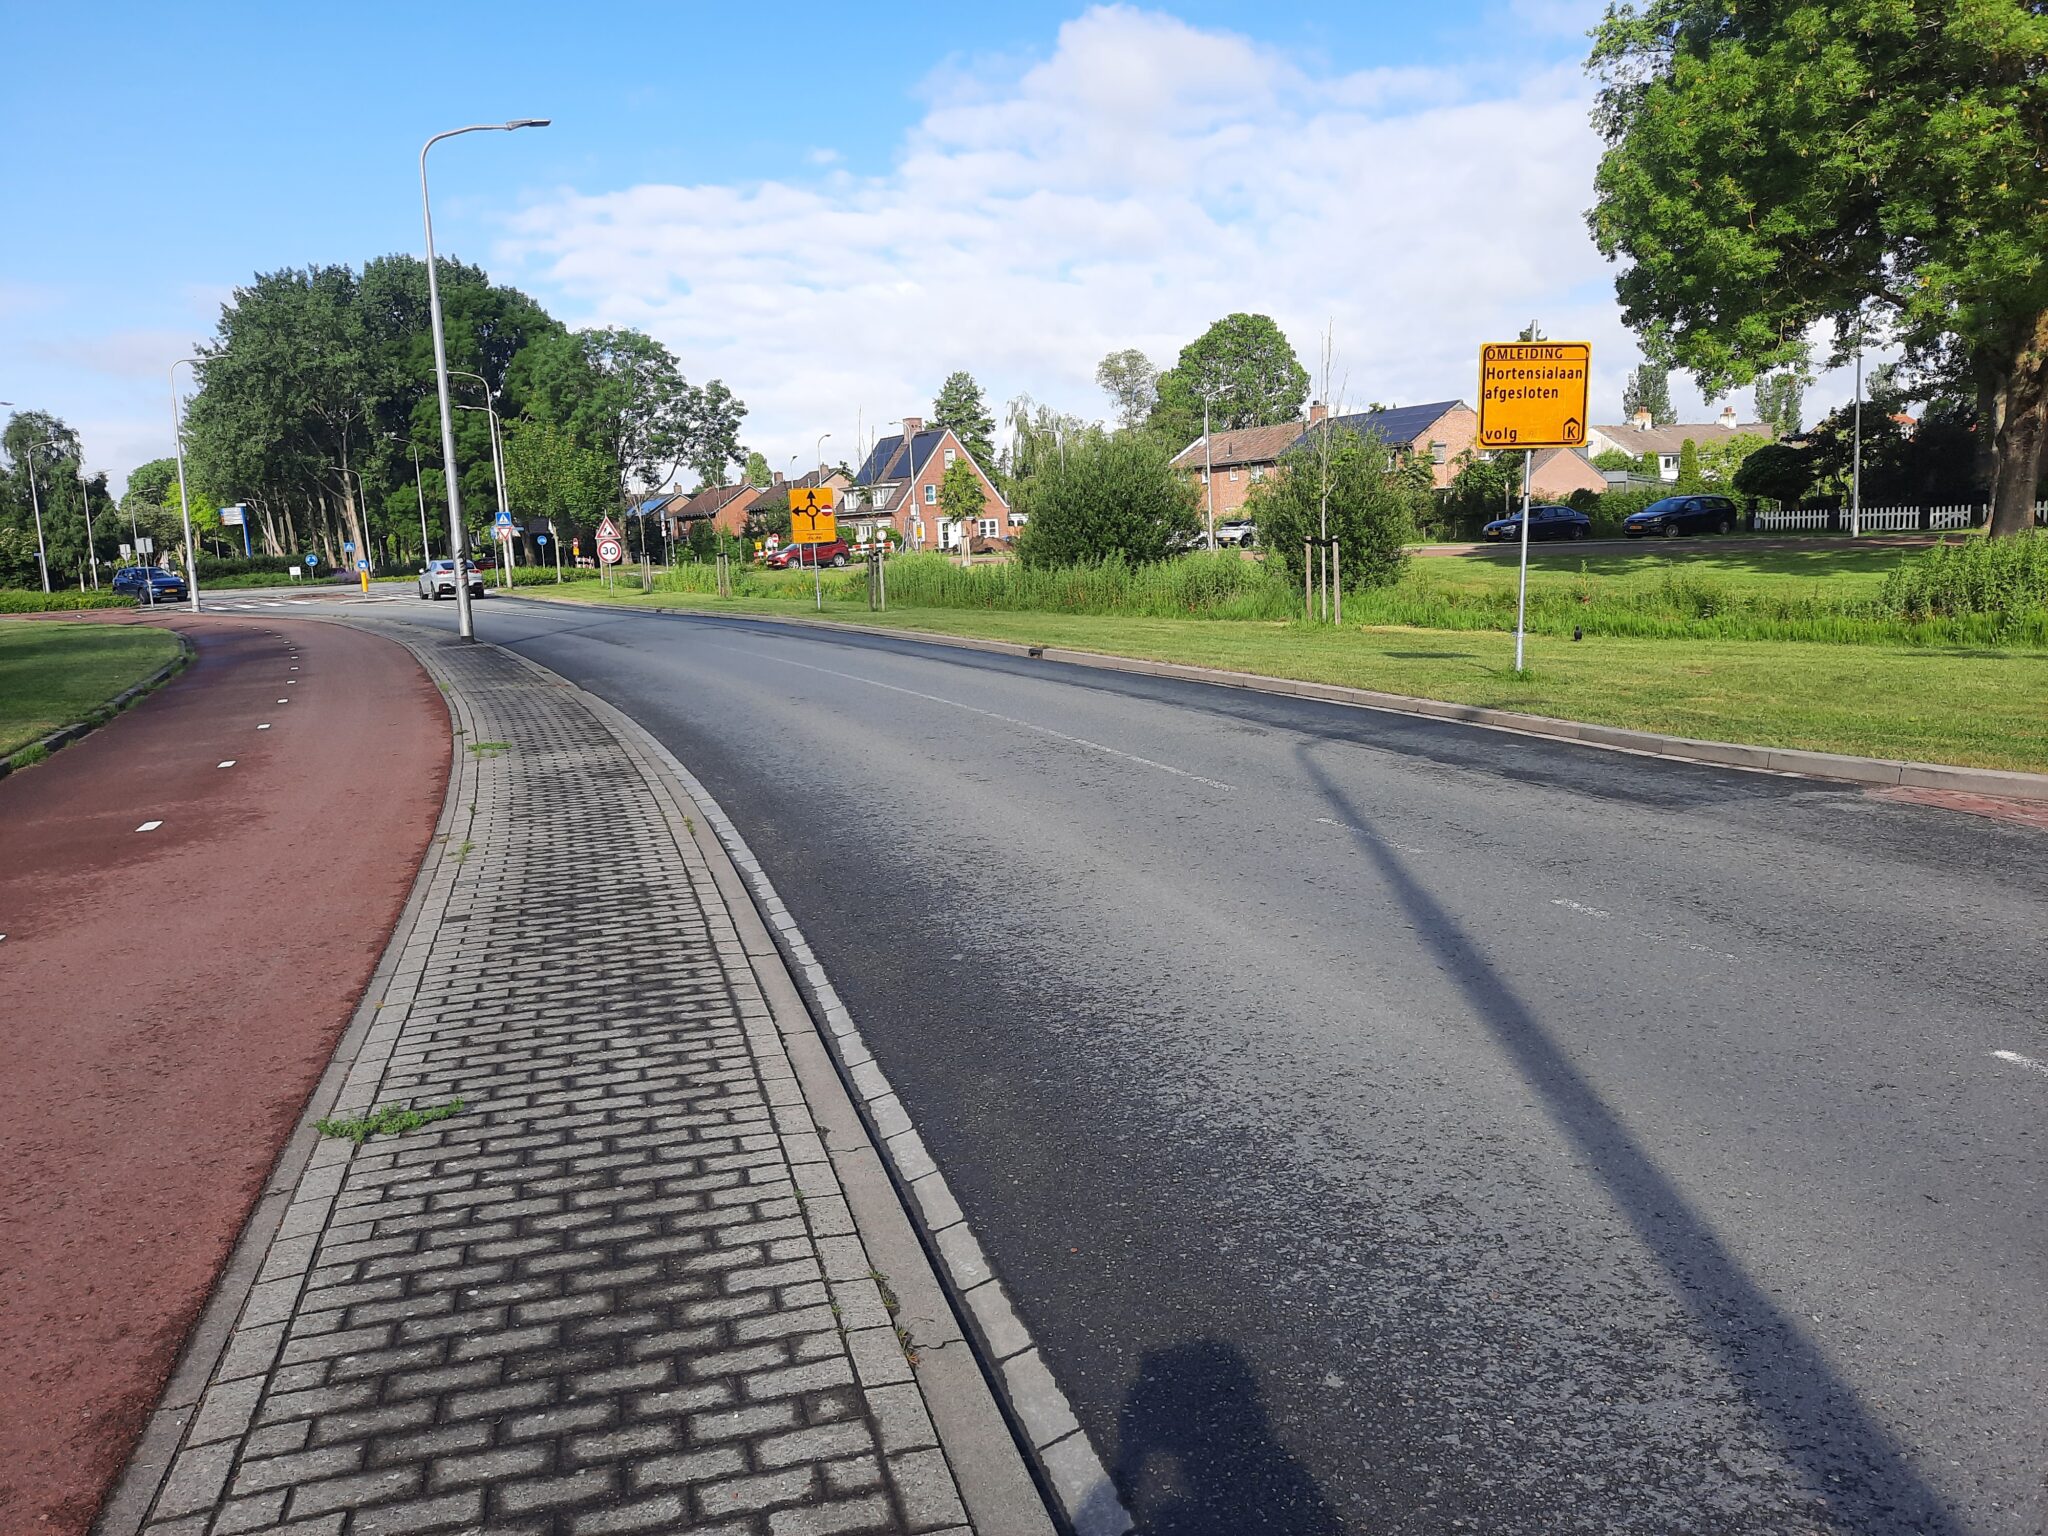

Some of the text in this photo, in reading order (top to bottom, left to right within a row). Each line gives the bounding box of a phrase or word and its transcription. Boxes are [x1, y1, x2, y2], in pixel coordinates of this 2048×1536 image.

[1486, 348, 1563, 360] OMLEIDING
[1486, 366, 1583, 380] Hortensialaan
[1485, 386, 1559, 403] afgesloten
[1485, 426, 1577, 443] volg K
[602, 546, 617, 556] 30
